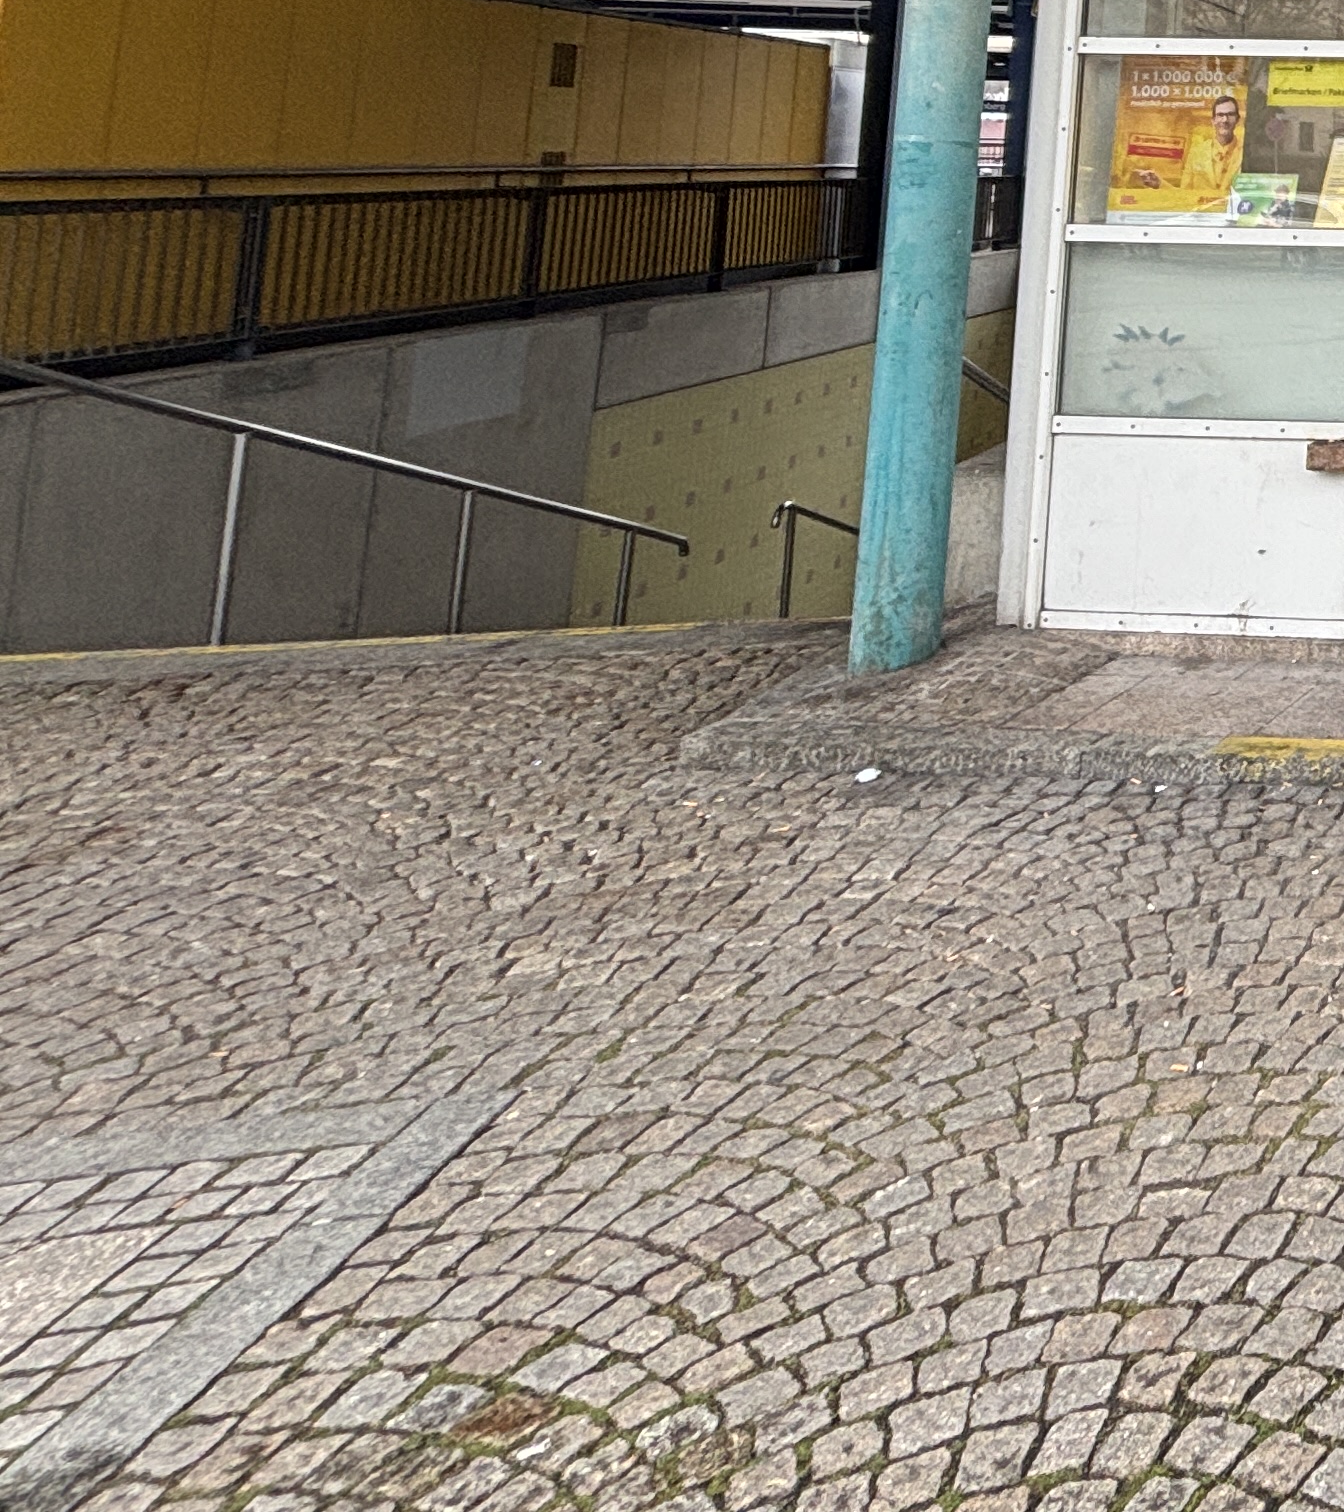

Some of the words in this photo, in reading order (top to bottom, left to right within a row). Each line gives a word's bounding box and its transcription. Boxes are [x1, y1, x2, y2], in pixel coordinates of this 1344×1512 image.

[1153, 70, 1223, 83] 1.000.000
[1131, 85, 1170, 98] 1.000
[1184, 86, 1222, 99] 1.000
